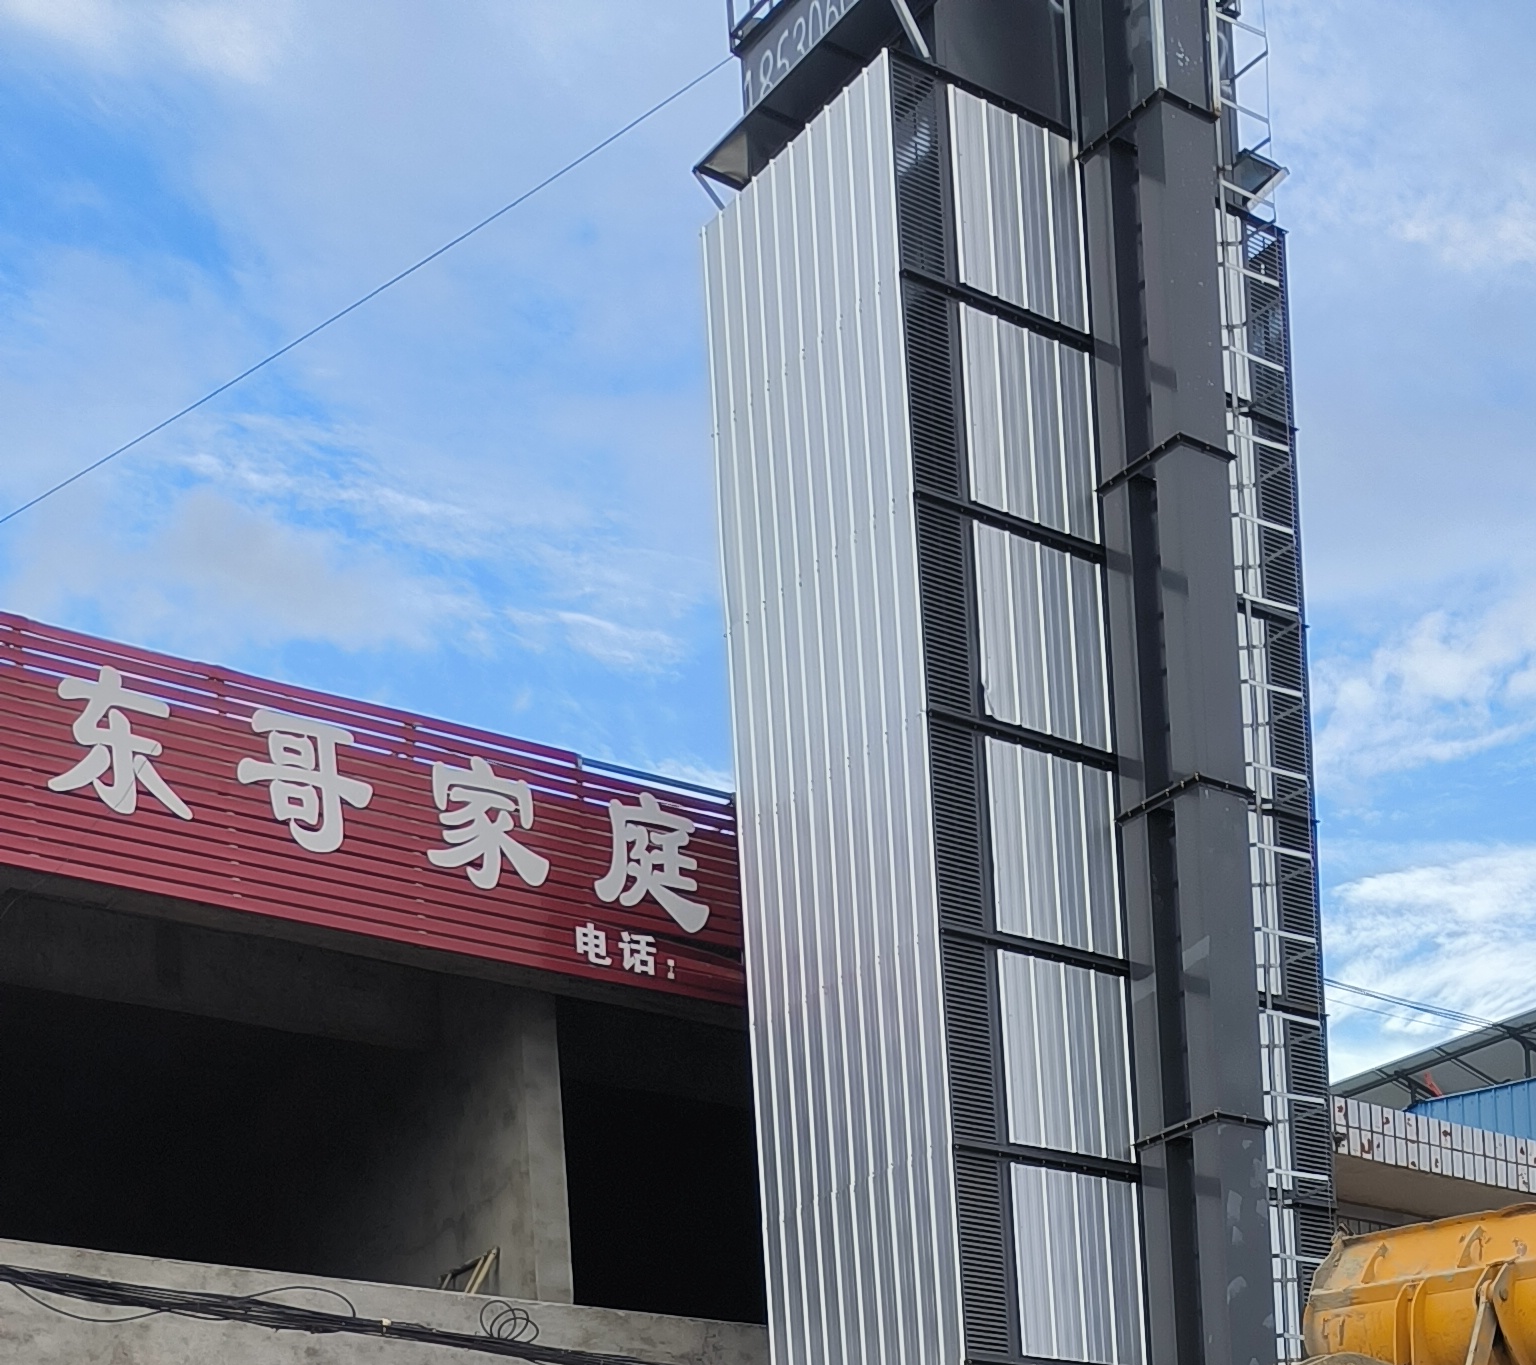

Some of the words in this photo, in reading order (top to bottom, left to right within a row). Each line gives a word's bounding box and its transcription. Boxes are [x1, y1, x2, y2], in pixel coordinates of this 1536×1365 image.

[743, 0, 850, 106] 185306
[48, 666, 710, 933] 东哥家庭
